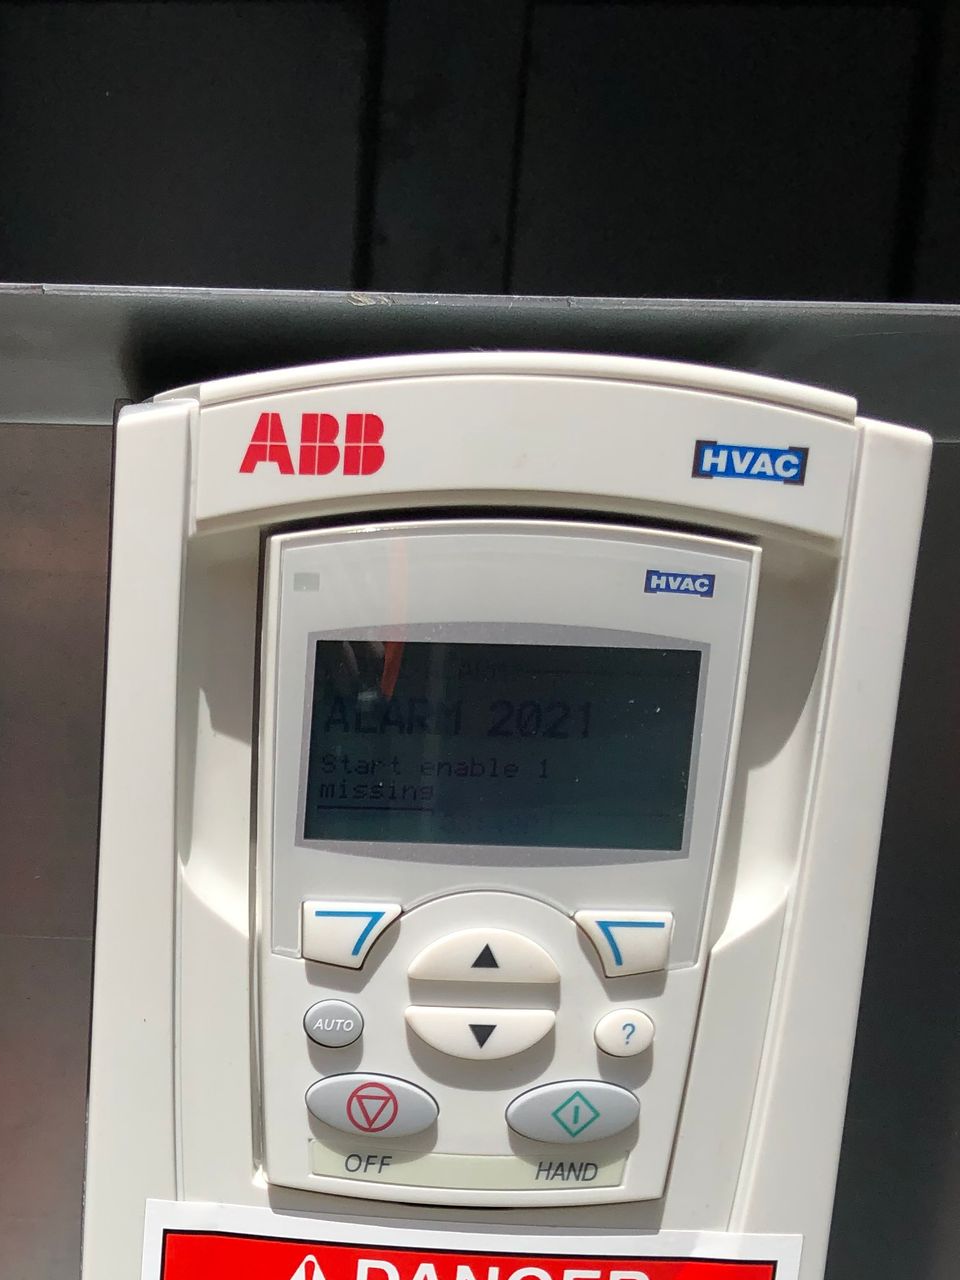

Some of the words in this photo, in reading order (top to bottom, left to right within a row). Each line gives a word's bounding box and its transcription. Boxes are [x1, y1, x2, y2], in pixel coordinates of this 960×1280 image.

[238, 412, 385, 476] ABB
[702, 448, 800, 479] HVAC
[648, 573, 710, 592] HVAC
[489, 701, 592, 739] 2021
[321, 754, 401, 774] Start
[421, 758, 519, 778] enable
[320, 781, 433, 800] missing
[311, 1016, 355, 1033] AUTO
[343, 1153, 392, 1174] OFF
[535, 1160, 599, 1182] HAND
